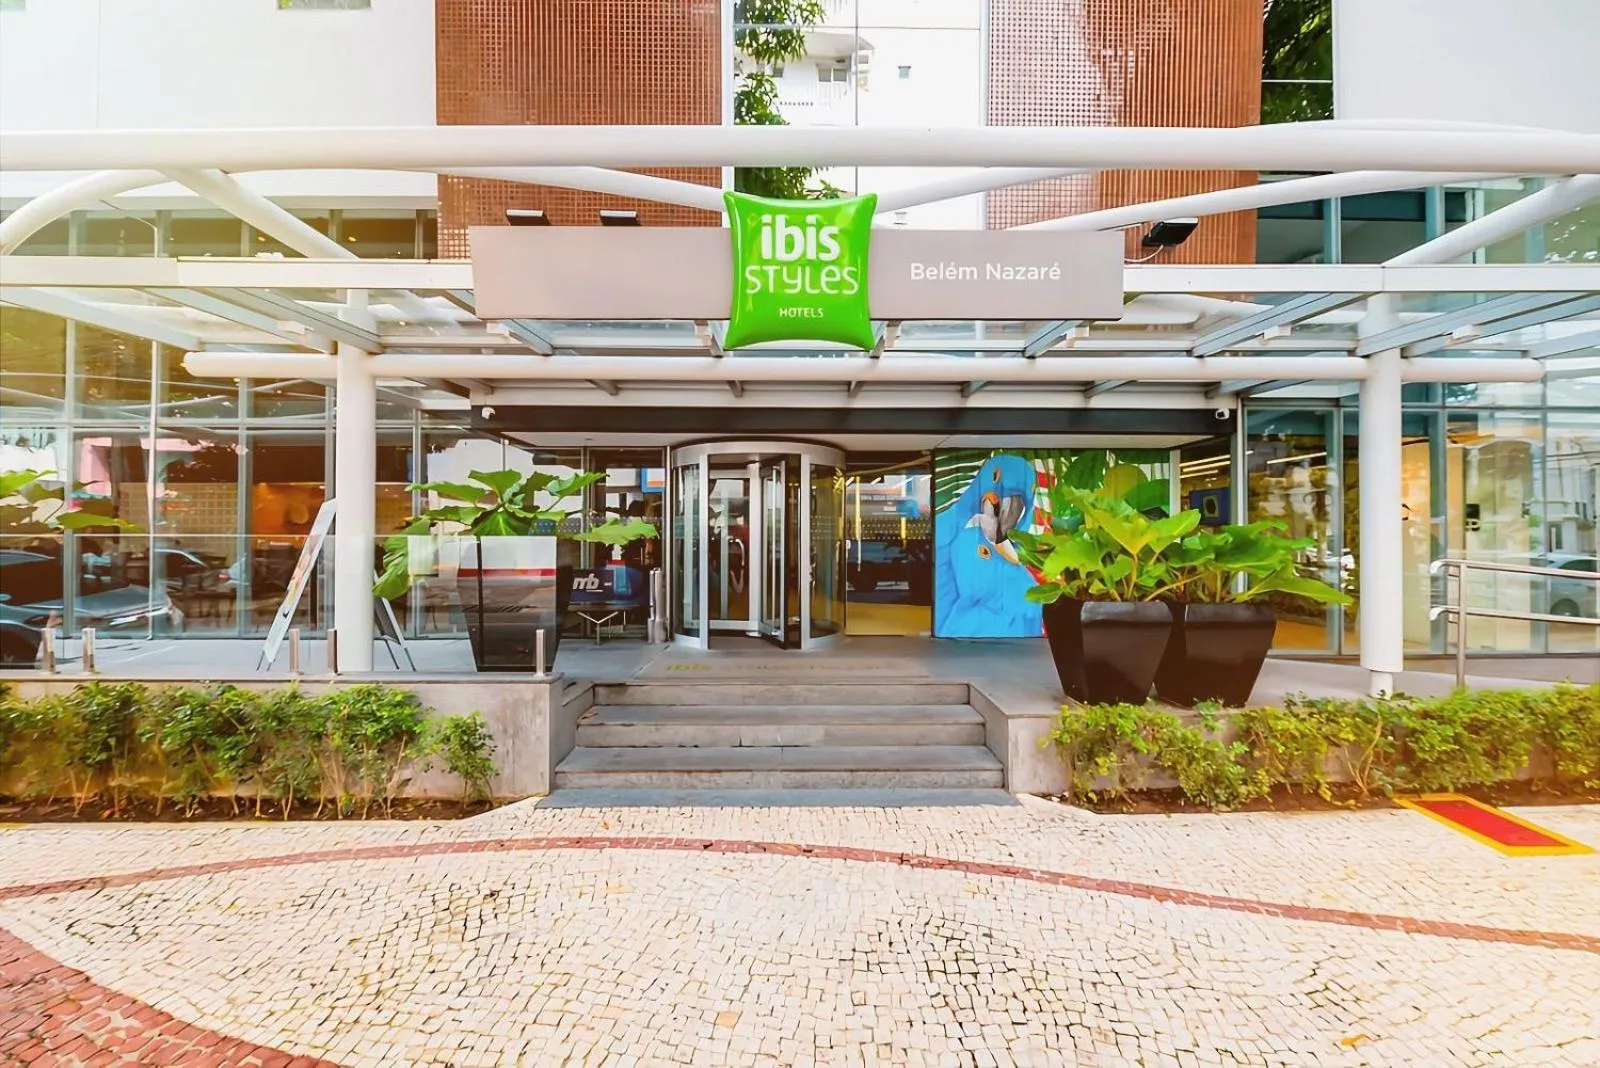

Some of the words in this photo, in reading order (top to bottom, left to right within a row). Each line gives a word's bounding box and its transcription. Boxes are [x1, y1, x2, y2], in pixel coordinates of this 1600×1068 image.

[761, 213, 841, 261] ibis
[910, 261, 978, 281] Belém
[985, 261, 1062, 281] Nazaré
[779, 307, 825, 318] HOTELS
